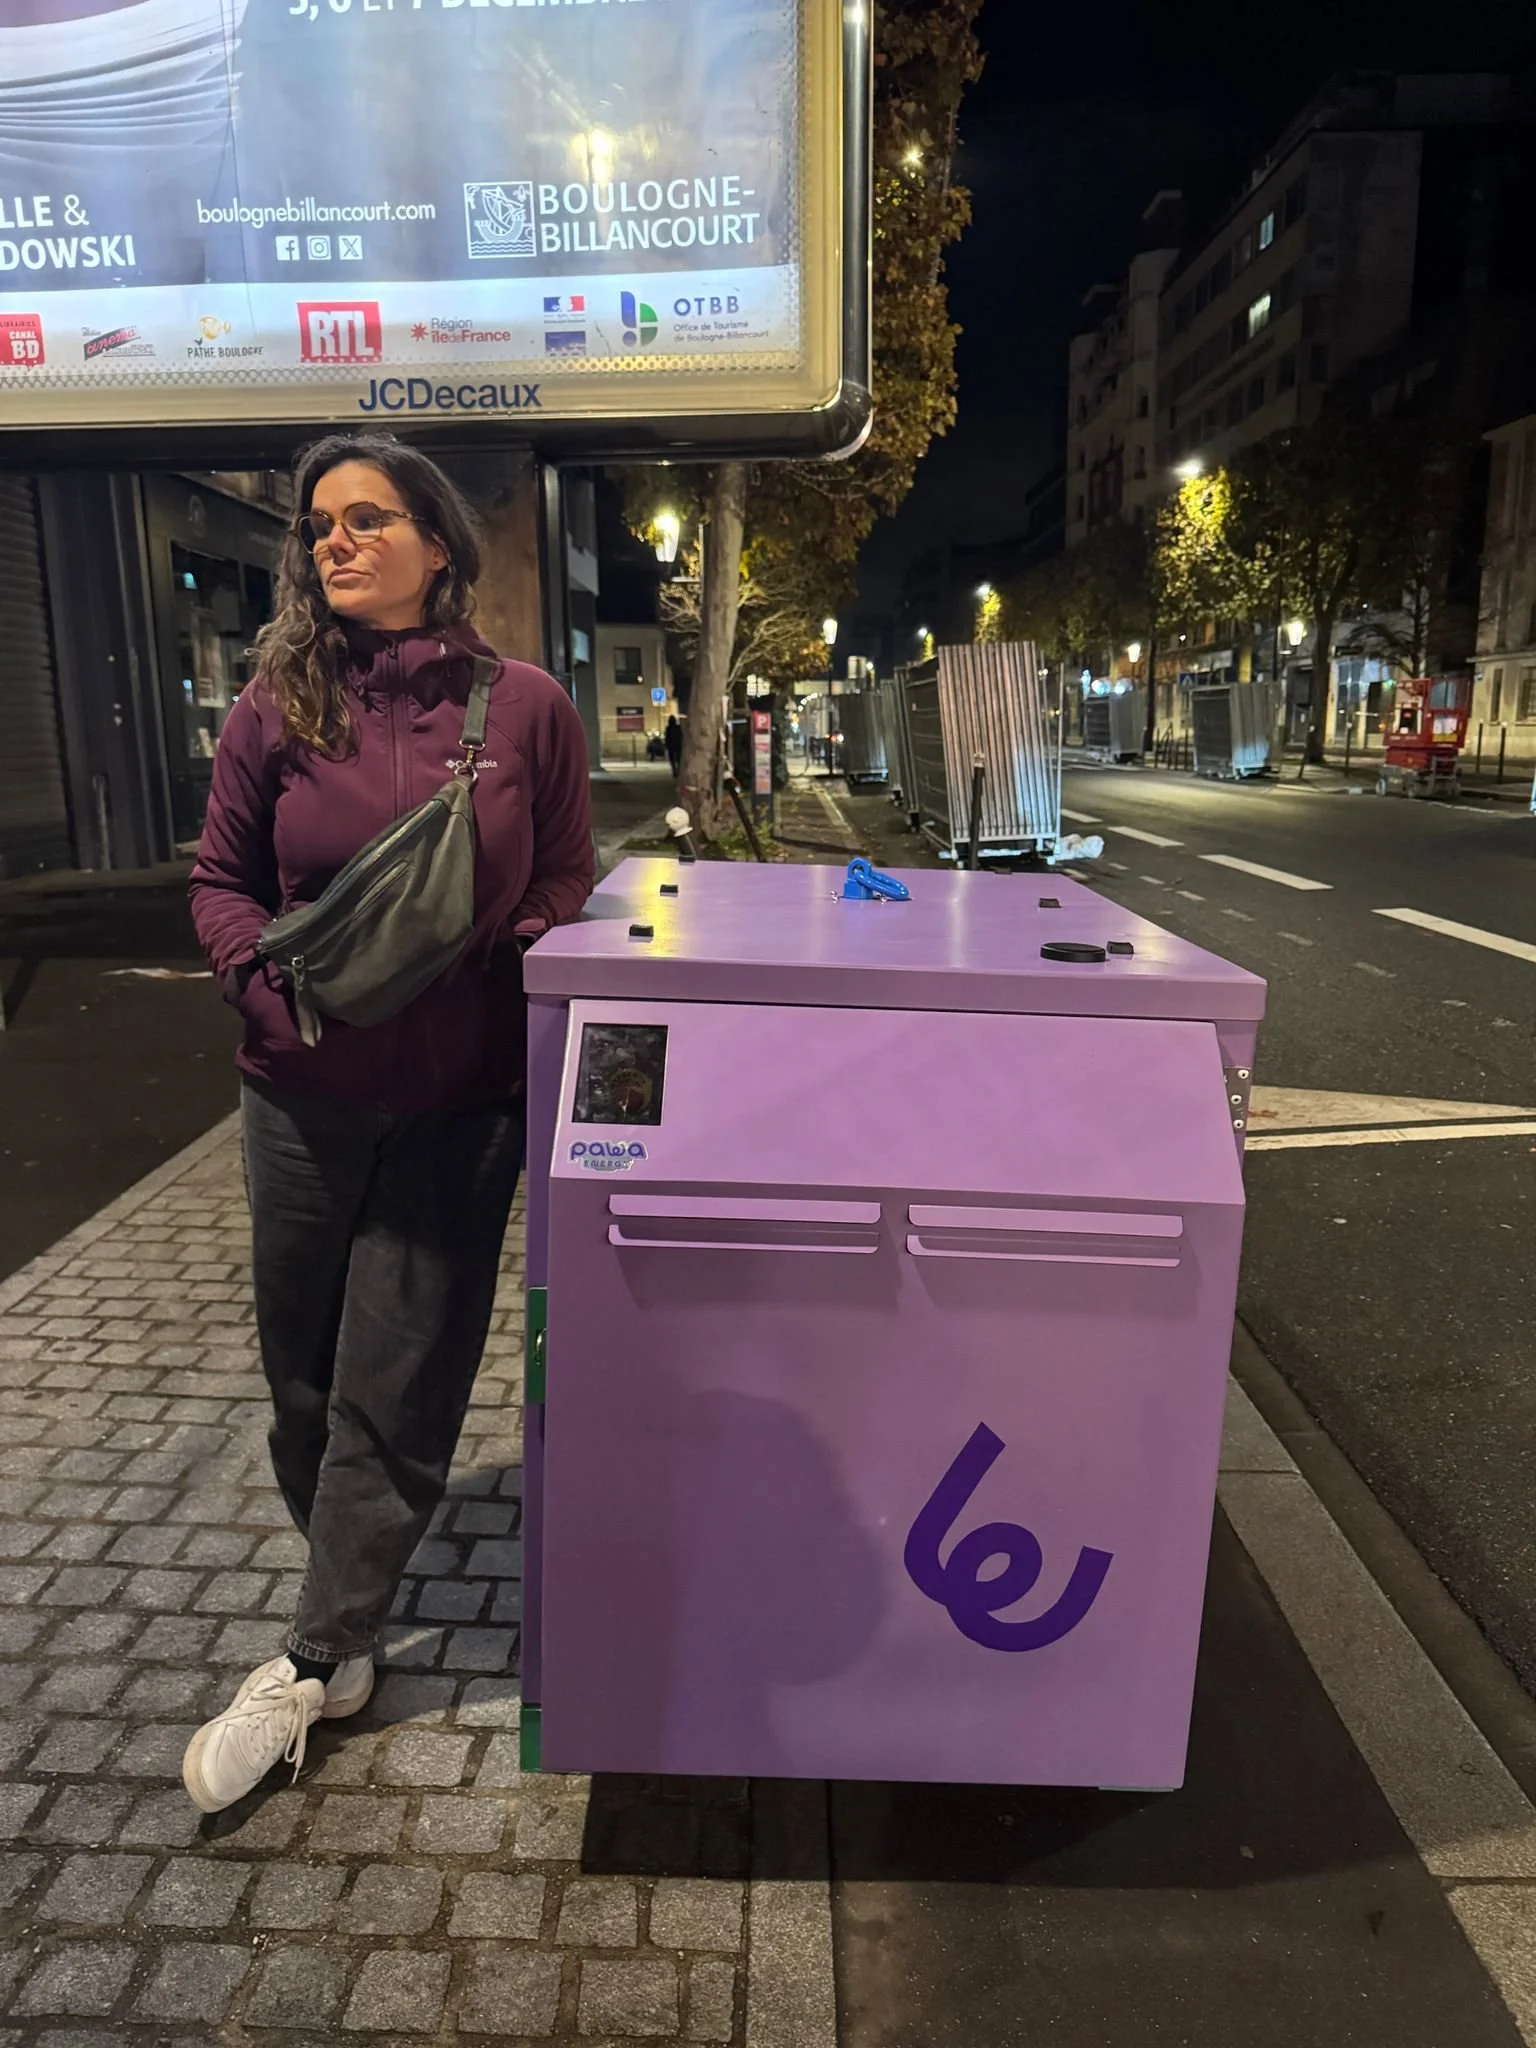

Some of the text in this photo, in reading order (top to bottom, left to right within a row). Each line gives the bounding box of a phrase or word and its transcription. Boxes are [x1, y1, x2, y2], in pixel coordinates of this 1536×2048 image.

[538, 175, 755, 215] BOULOGNE-
[64, 194, 90, 226] &
[197, 197, 436, 229] boulognebillancourt.com
[540, 213, 760, 253] BILLANCOURT
[673, 295, 739, 316] OTBB
[9, 331, 37, 339] CANAL
[307, 310, 374, 357] RTL
[431, 317, 473, 332] Région
[673, 321, 749, 332] Office de Tourisme
[11, 340, 40, 359] BD
[359, 378, 542, 411] JCDecaux
[571, 1142, 645, 1160] pawa
